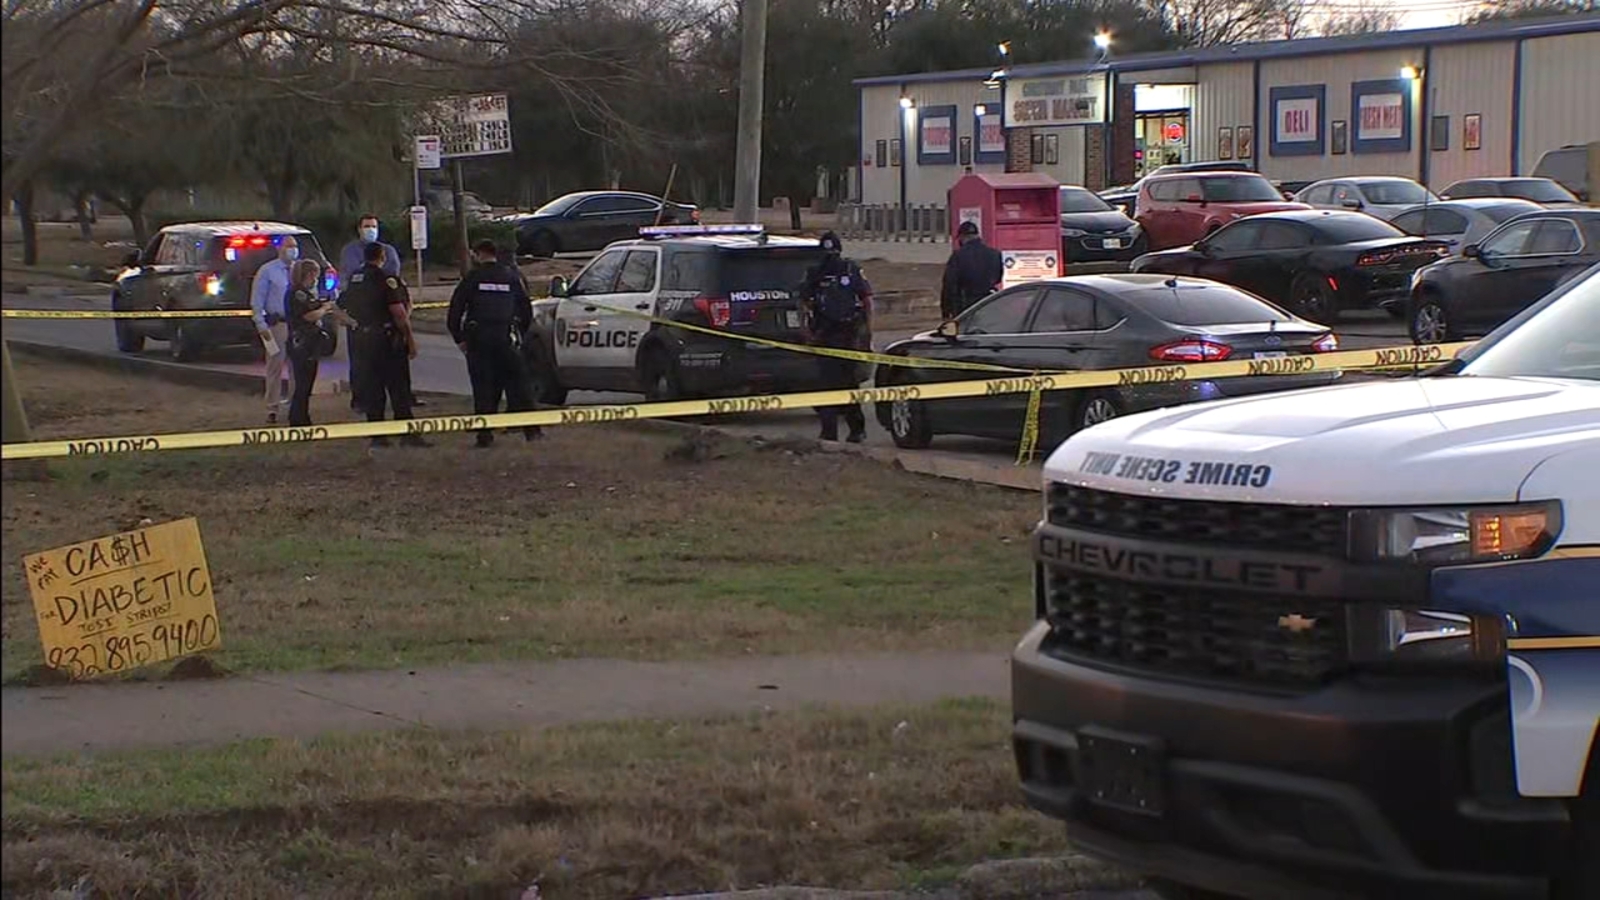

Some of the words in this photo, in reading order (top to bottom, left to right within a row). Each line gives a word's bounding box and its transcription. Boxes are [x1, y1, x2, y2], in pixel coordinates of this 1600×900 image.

[1284, 109, 1310, 134] DELI
[1383, 104, 1403, 130] MEAT
[730, 290, 790, 302] HOUSTON
[566, 330, 638, 348] POLICE
[1248, 356, 1315, 375] CAUTION
[1375, 346, 1441, 366] CAUTION
[1118, 366, 1186, 385] CAUTION
[849, 386, 921, 404] CAUTION
[708, 396, 782, 414] CAUTION
[406, 416, 487, 435] CAUTION
[560, 407, 638, 425] CAUTION
[242, 426, 328, 445] CAUTION
[67, 438, 160, 456] CAUTION
[65, 531, 151, 577] CA$H
[1039, 534, 1323, 592] CHEVROLET
[29, 556, 49, 574] WE
[37, 568, 60, 590] PAY
[54, 567, 207, 626] DIABETIC
